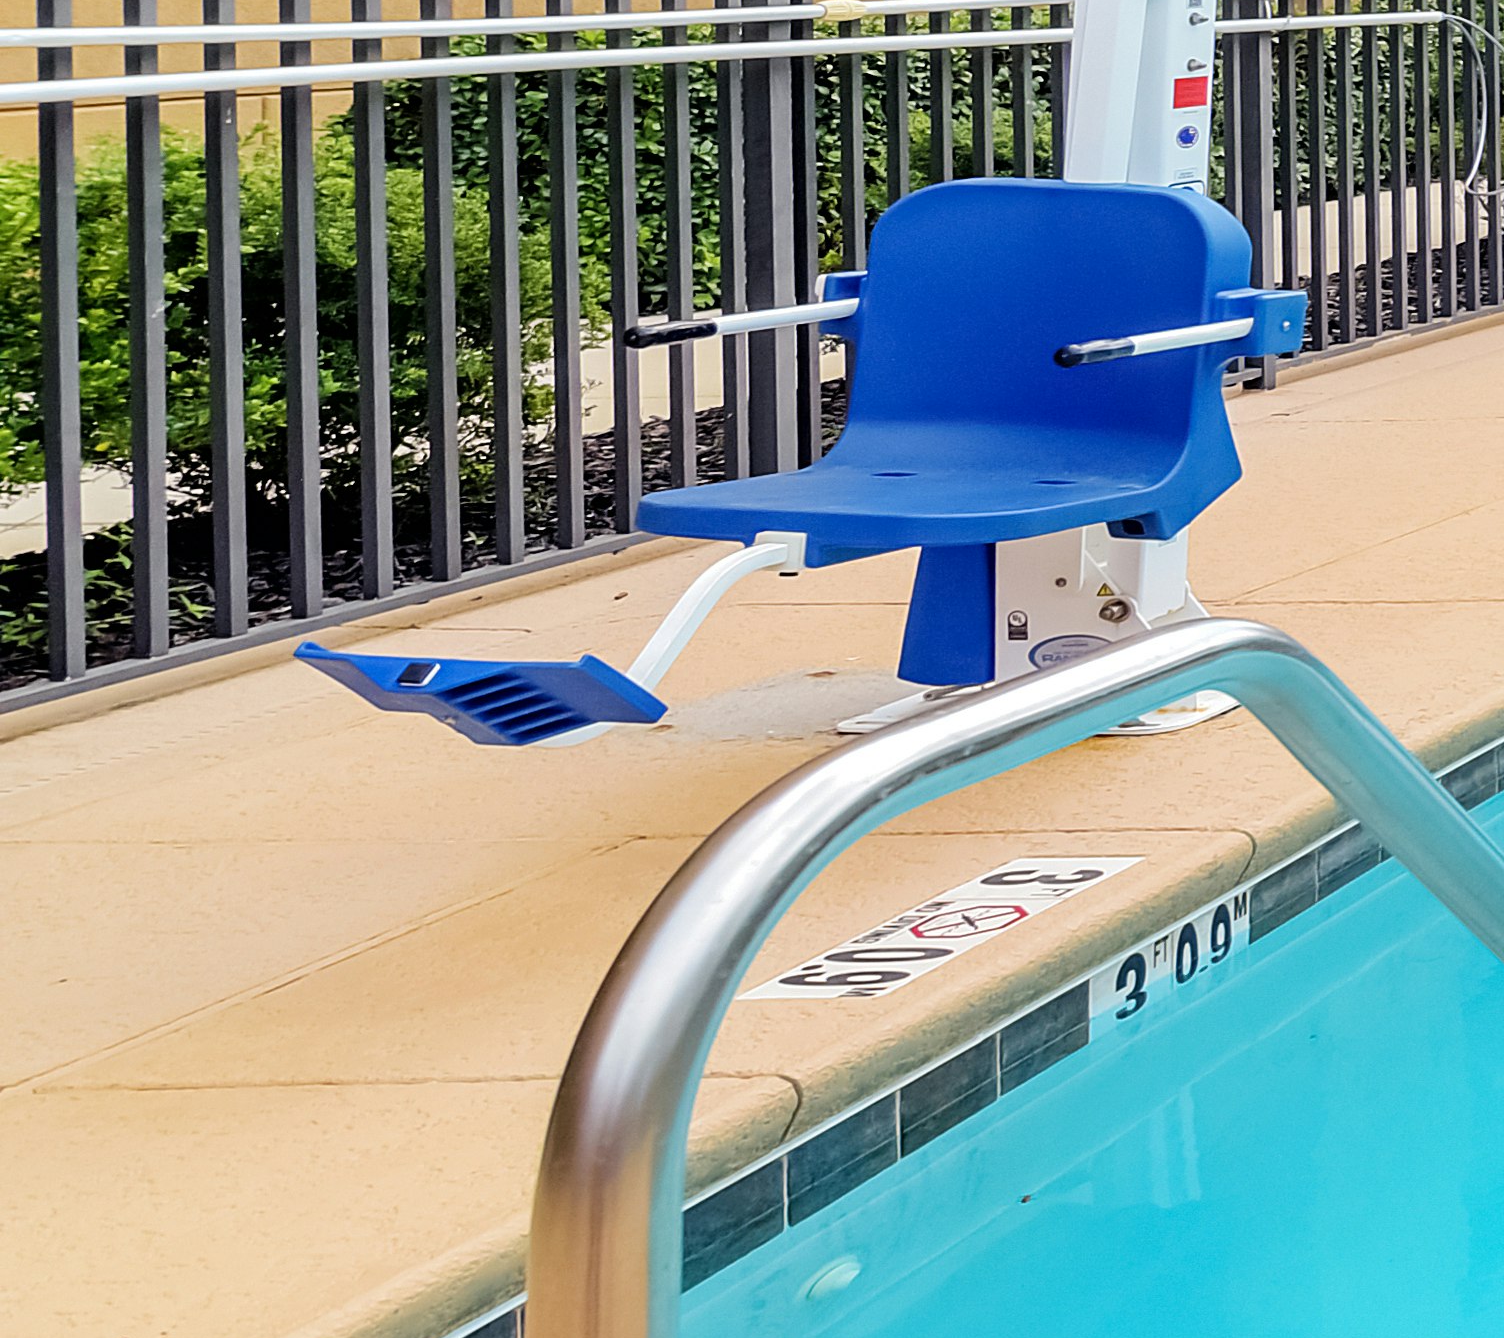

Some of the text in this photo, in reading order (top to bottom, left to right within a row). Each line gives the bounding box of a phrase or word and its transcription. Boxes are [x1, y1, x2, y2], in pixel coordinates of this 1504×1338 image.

[980, 869, 1104, 886] 3
[1115, 952, 1148, 1020] 3
[1153, 935, 1169, 969] FT
[1234, 891, 1247, 921] M
